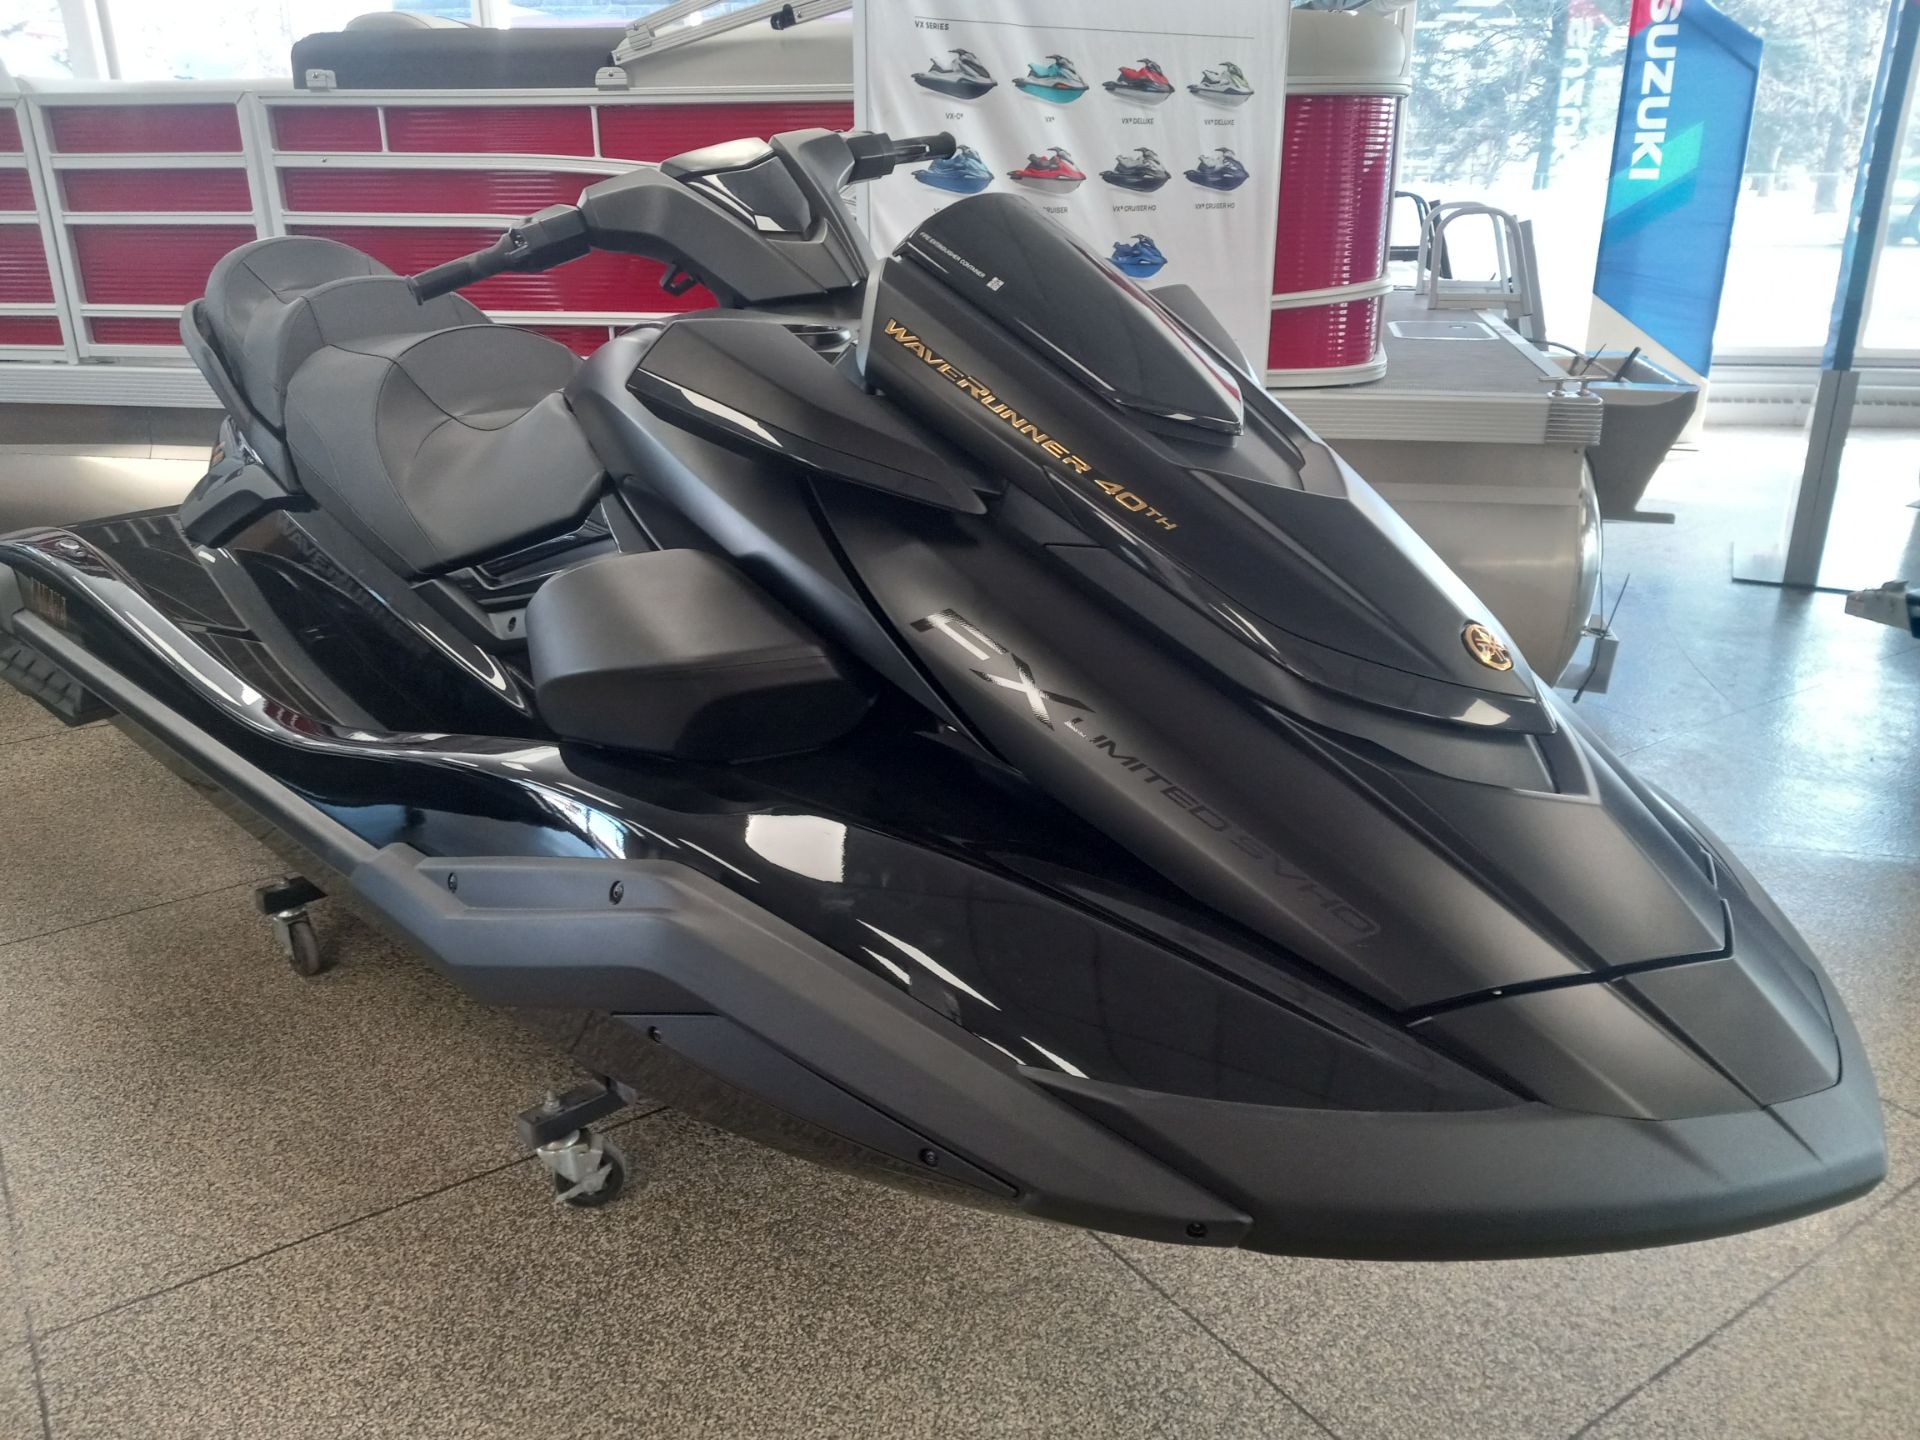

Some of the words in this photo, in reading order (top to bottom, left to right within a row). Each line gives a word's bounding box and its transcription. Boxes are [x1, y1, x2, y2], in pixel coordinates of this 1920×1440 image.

[914, 20, 924, 28] VX
[926, 21, 950, 31] SERIES
[1133, 117, 1154, 126] DELUXE
[1629, 0, 1682, 180] SUZUKI
[1124, 204, 1147, 212] CRUISER
[884, 317, 1092, 474] WAVERUNNER
[1094, 478, 1178, 530] 40TH
[1063, 716, 1232, 832] LIMITED
